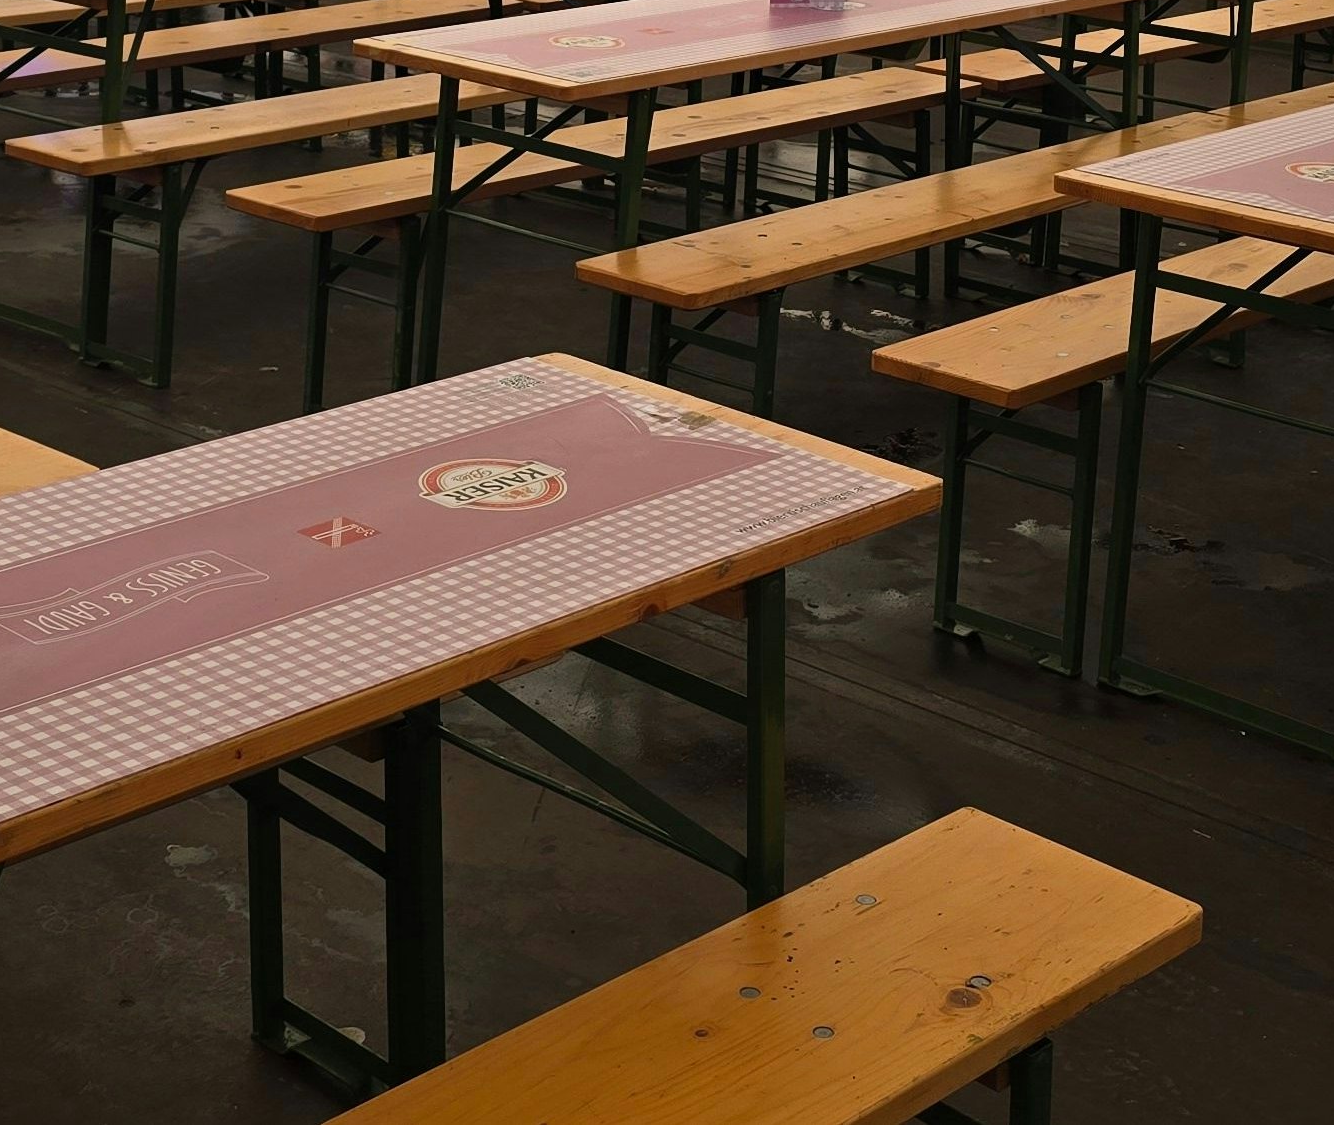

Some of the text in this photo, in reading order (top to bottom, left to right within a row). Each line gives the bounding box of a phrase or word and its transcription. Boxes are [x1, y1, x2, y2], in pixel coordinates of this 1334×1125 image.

[444, 467, 549, 502] KAISER
[23, 559, 221, 635] GENUSS & GAUDI
